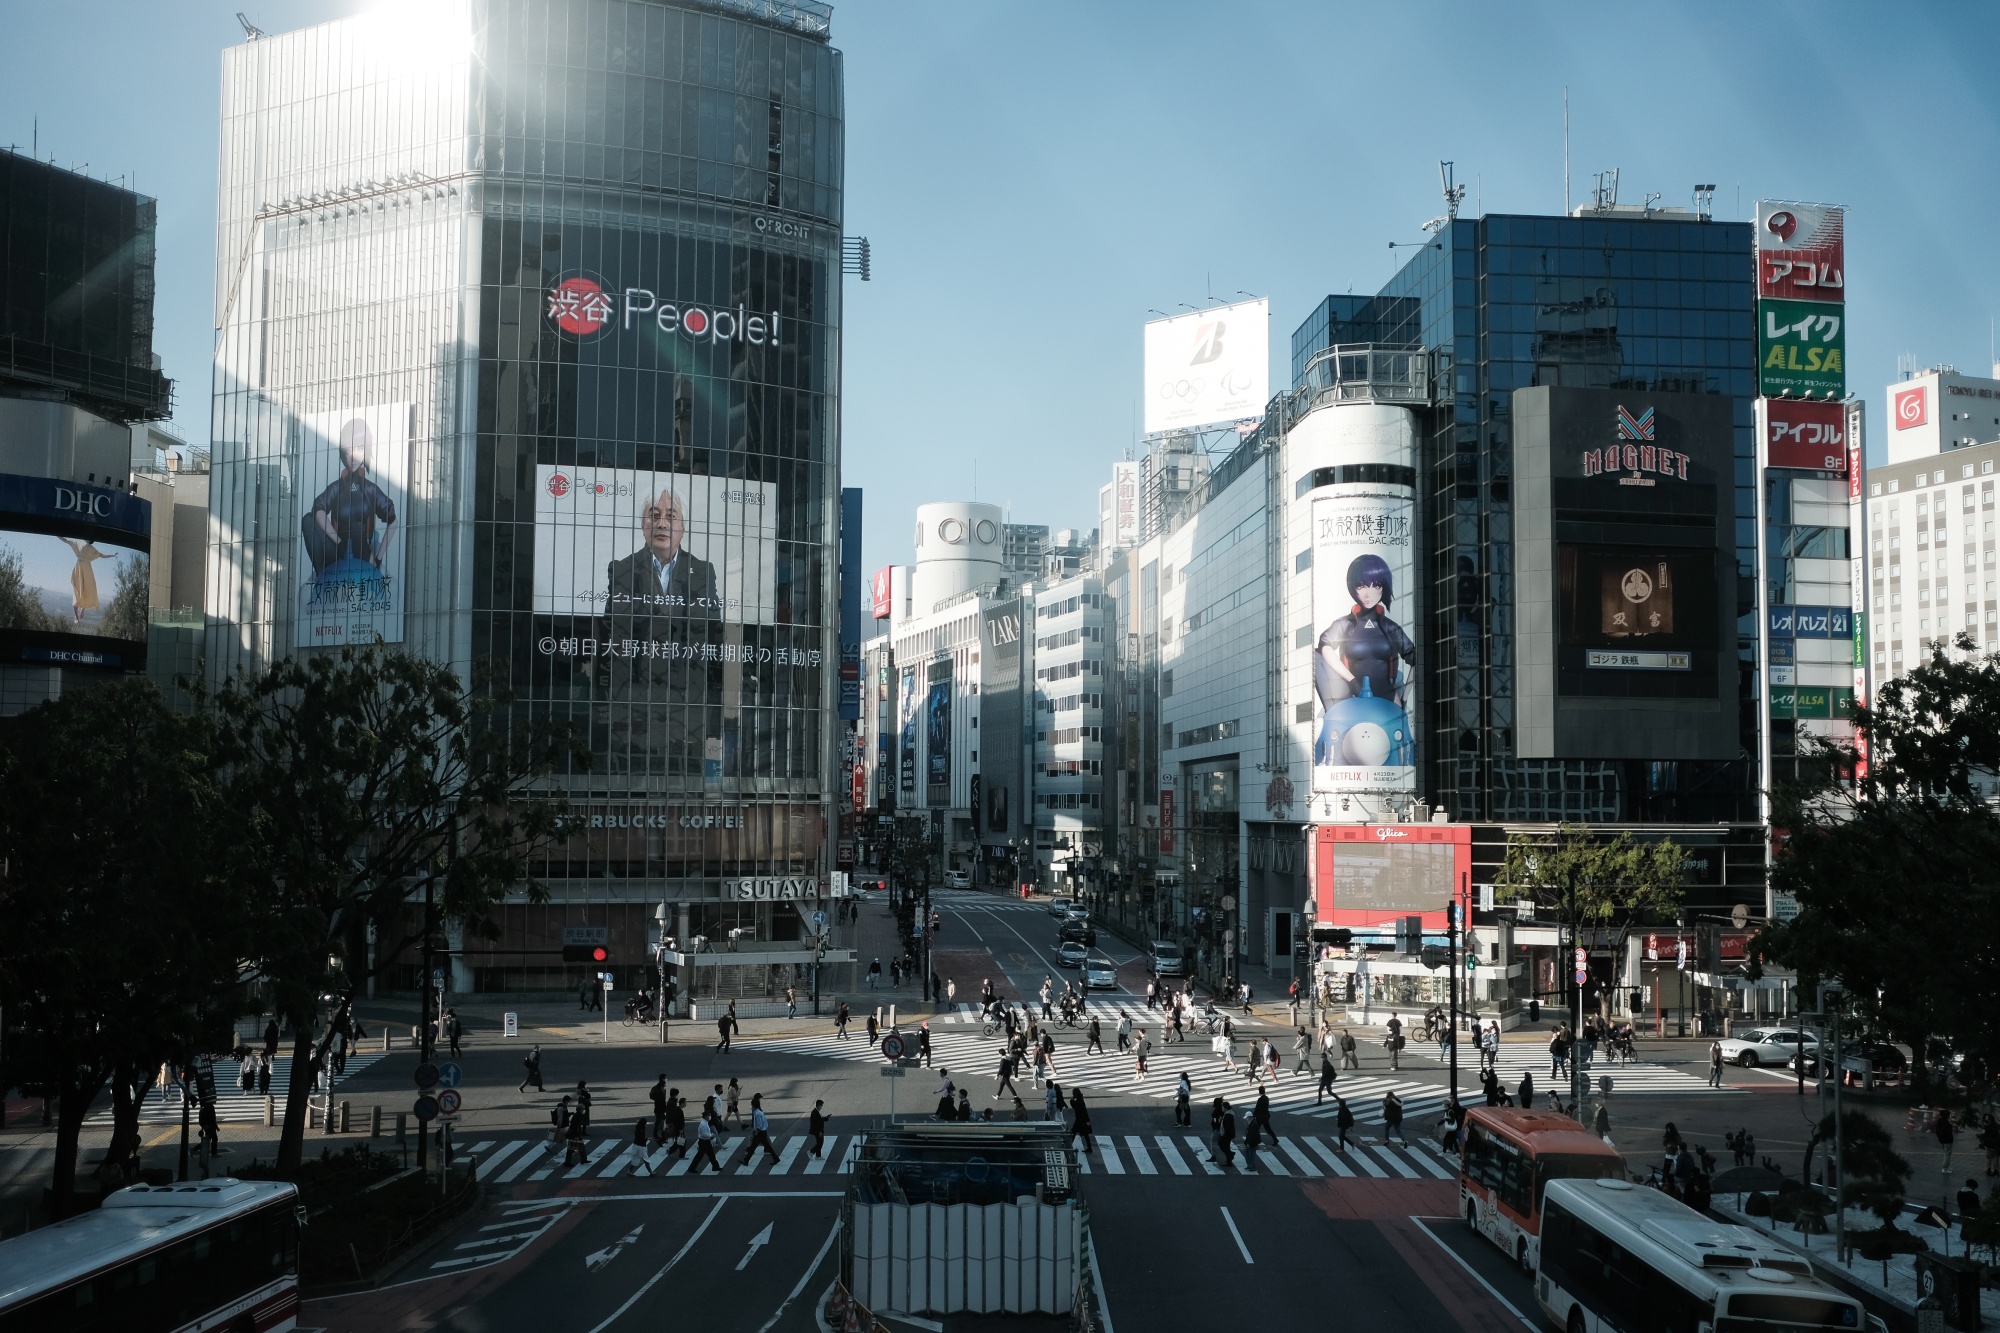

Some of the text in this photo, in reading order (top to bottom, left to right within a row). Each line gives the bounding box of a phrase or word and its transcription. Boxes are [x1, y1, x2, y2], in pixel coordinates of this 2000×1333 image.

[1766, 258, 1843, 288] アコム
[547, 287, 780, 346] 渋谷 People!
[1766, 311, 1841, 343] レイク
[1764, 344, 1842, 373] ALSA
[1770, 421, 1842, 446] アイフル
[1583, 444, 1691, 481] MAGNET
[1824, 455, 1843, 468] 8F
[1852, 460, 1860, 496] アイフル
[53, 486, 111, 518] DHC
[1119, 468, 1135, 529] 大和証券
[315, 625, 342, 637] NETFLIX
[988, 615, 1019, 647] ZARA
[50, 651, 103, 663] DHC Channel
[1592, 654, 1619, 664] ゴジラ
[841, 642, 859, 706] SEIBU
[1777, 675, 1787, 683] 6F
[1771, 694, 1825, 705] レイク ALSA
[1331, 771, 1362, 782] NETFLIX
[680, 815, 744, 829] COFFEE
[1376, 827, 1409, 841] Glico
[840, 848, 851, 860] 本
[727, 879, 818, 899] TSUTAYA
[566, 929, 605, 938] 渋谷駅前
[1924, 1274, 1933, 1291] 27
